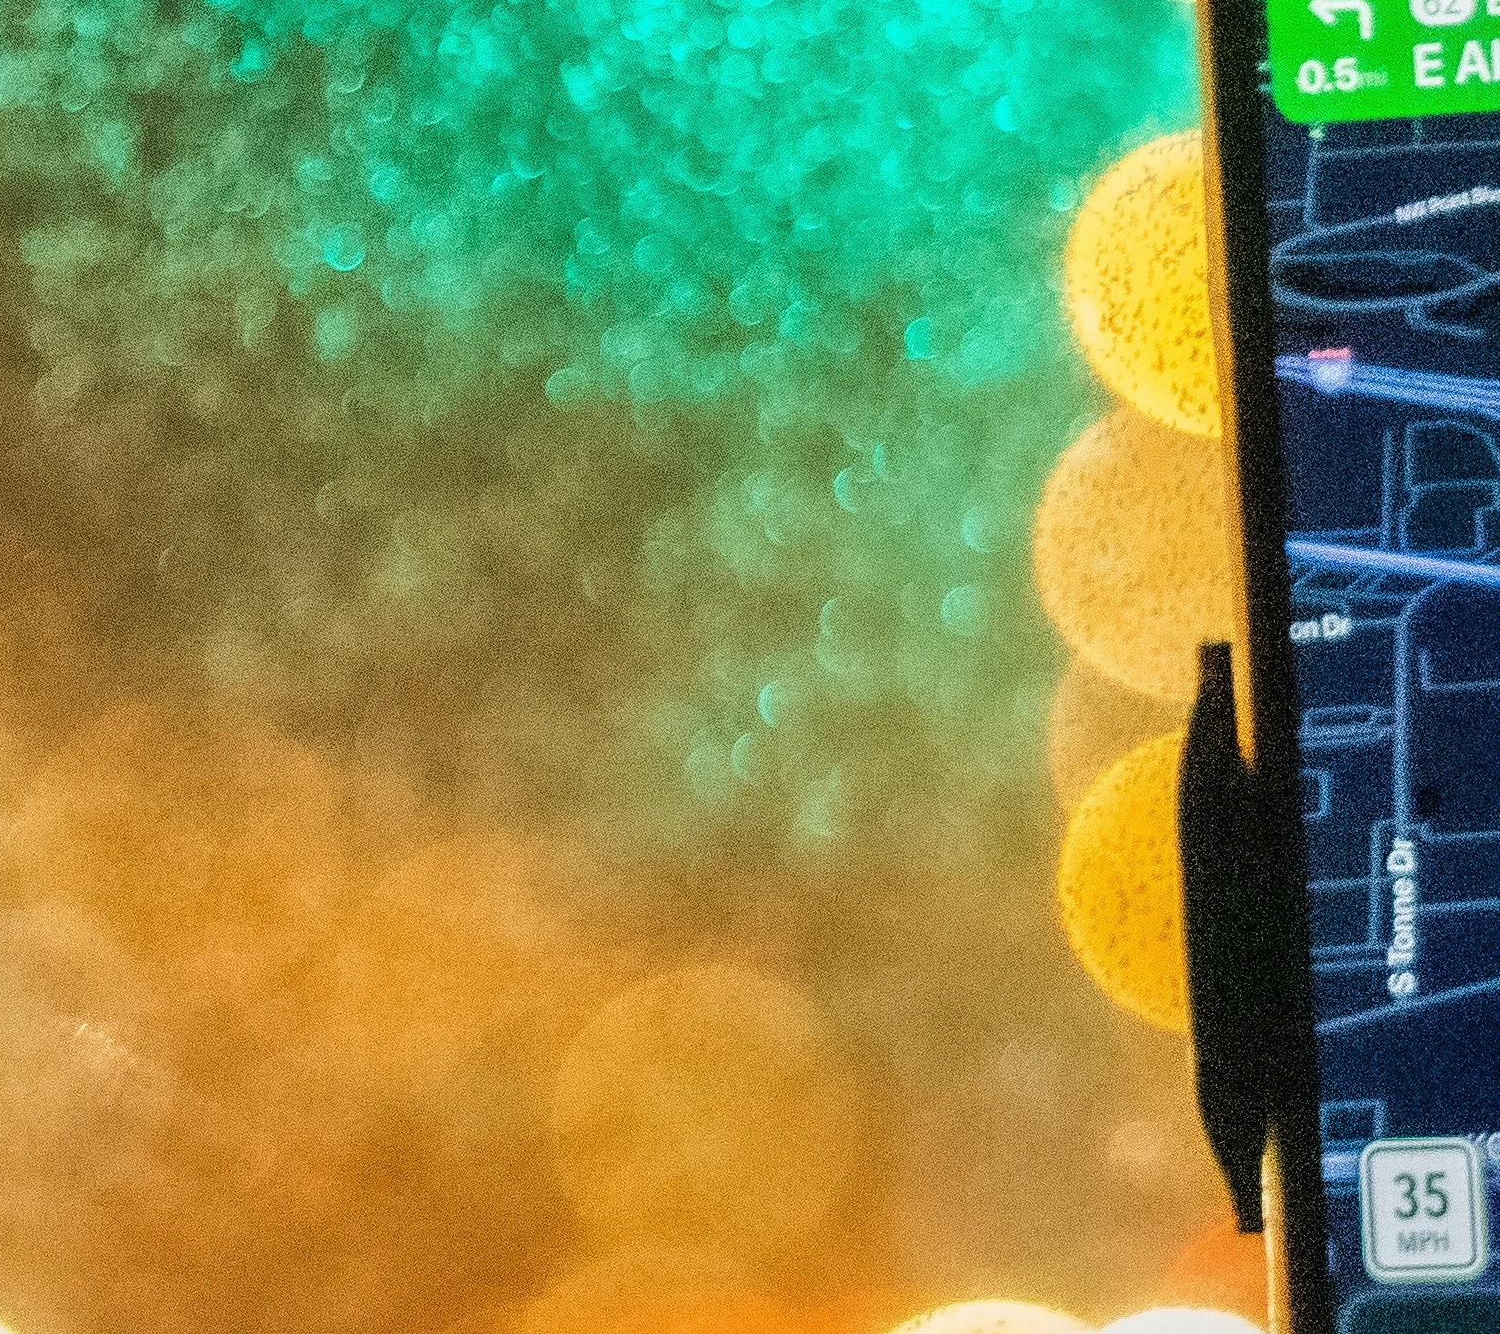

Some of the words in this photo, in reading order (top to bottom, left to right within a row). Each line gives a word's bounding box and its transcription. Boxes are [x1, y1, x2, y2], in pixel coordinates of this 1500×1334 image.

[1296, 56, 1360, 94] 0.5
[1412, 41, 1446, 88] E
[1386, 837, 1416, 873] Dr
[1387, 877, 1415, 967] Tonne
[1394, 1171, 1448, 1219] 35
[1397, 1230, 1450, 1254] MPH
